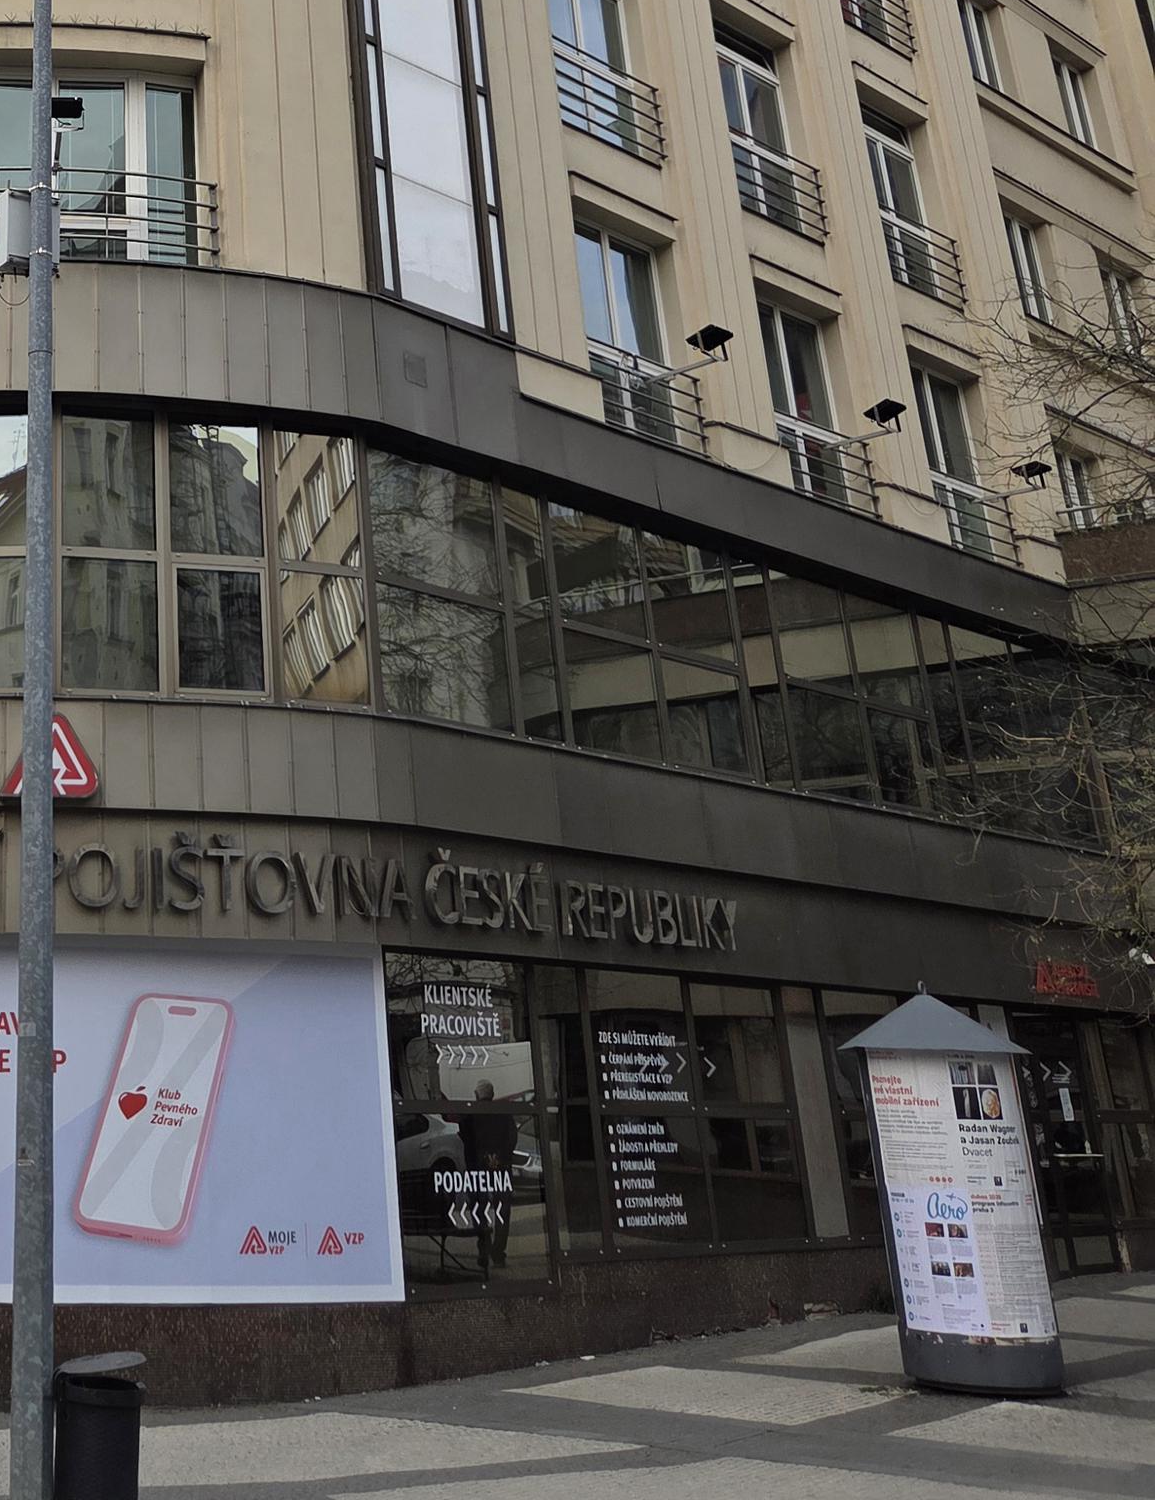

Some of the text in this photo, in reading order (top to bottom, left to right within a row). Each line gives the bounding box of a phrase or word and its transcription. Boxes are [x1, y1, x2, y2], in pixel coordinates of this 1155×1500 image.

[53, 831, 413, 918] OJIŠŤOVNA
[425, 847, 551, 932] ČESKÉ
[560, 879, 737, 950] REPUBLIKY
[424, 984, 493, 1008] KLIENTSKÉ
[421, 1012, 501, 1038] PRACOVIŠTĚ
[158, 1088, 181, 1100] Klub
[154, 1101, 198, 1116] Pevného
[150, 1114, 184, 1127] Zdraví
[962, 1147, 993, 1156] Dvacet
[434, 1170, 513, 1193] PODATELNA
[268, 1231, 297, 1245] MOJE
[345, 1233, 364, 1245] VZP
[269, 1245, 284, 1255] VZP
